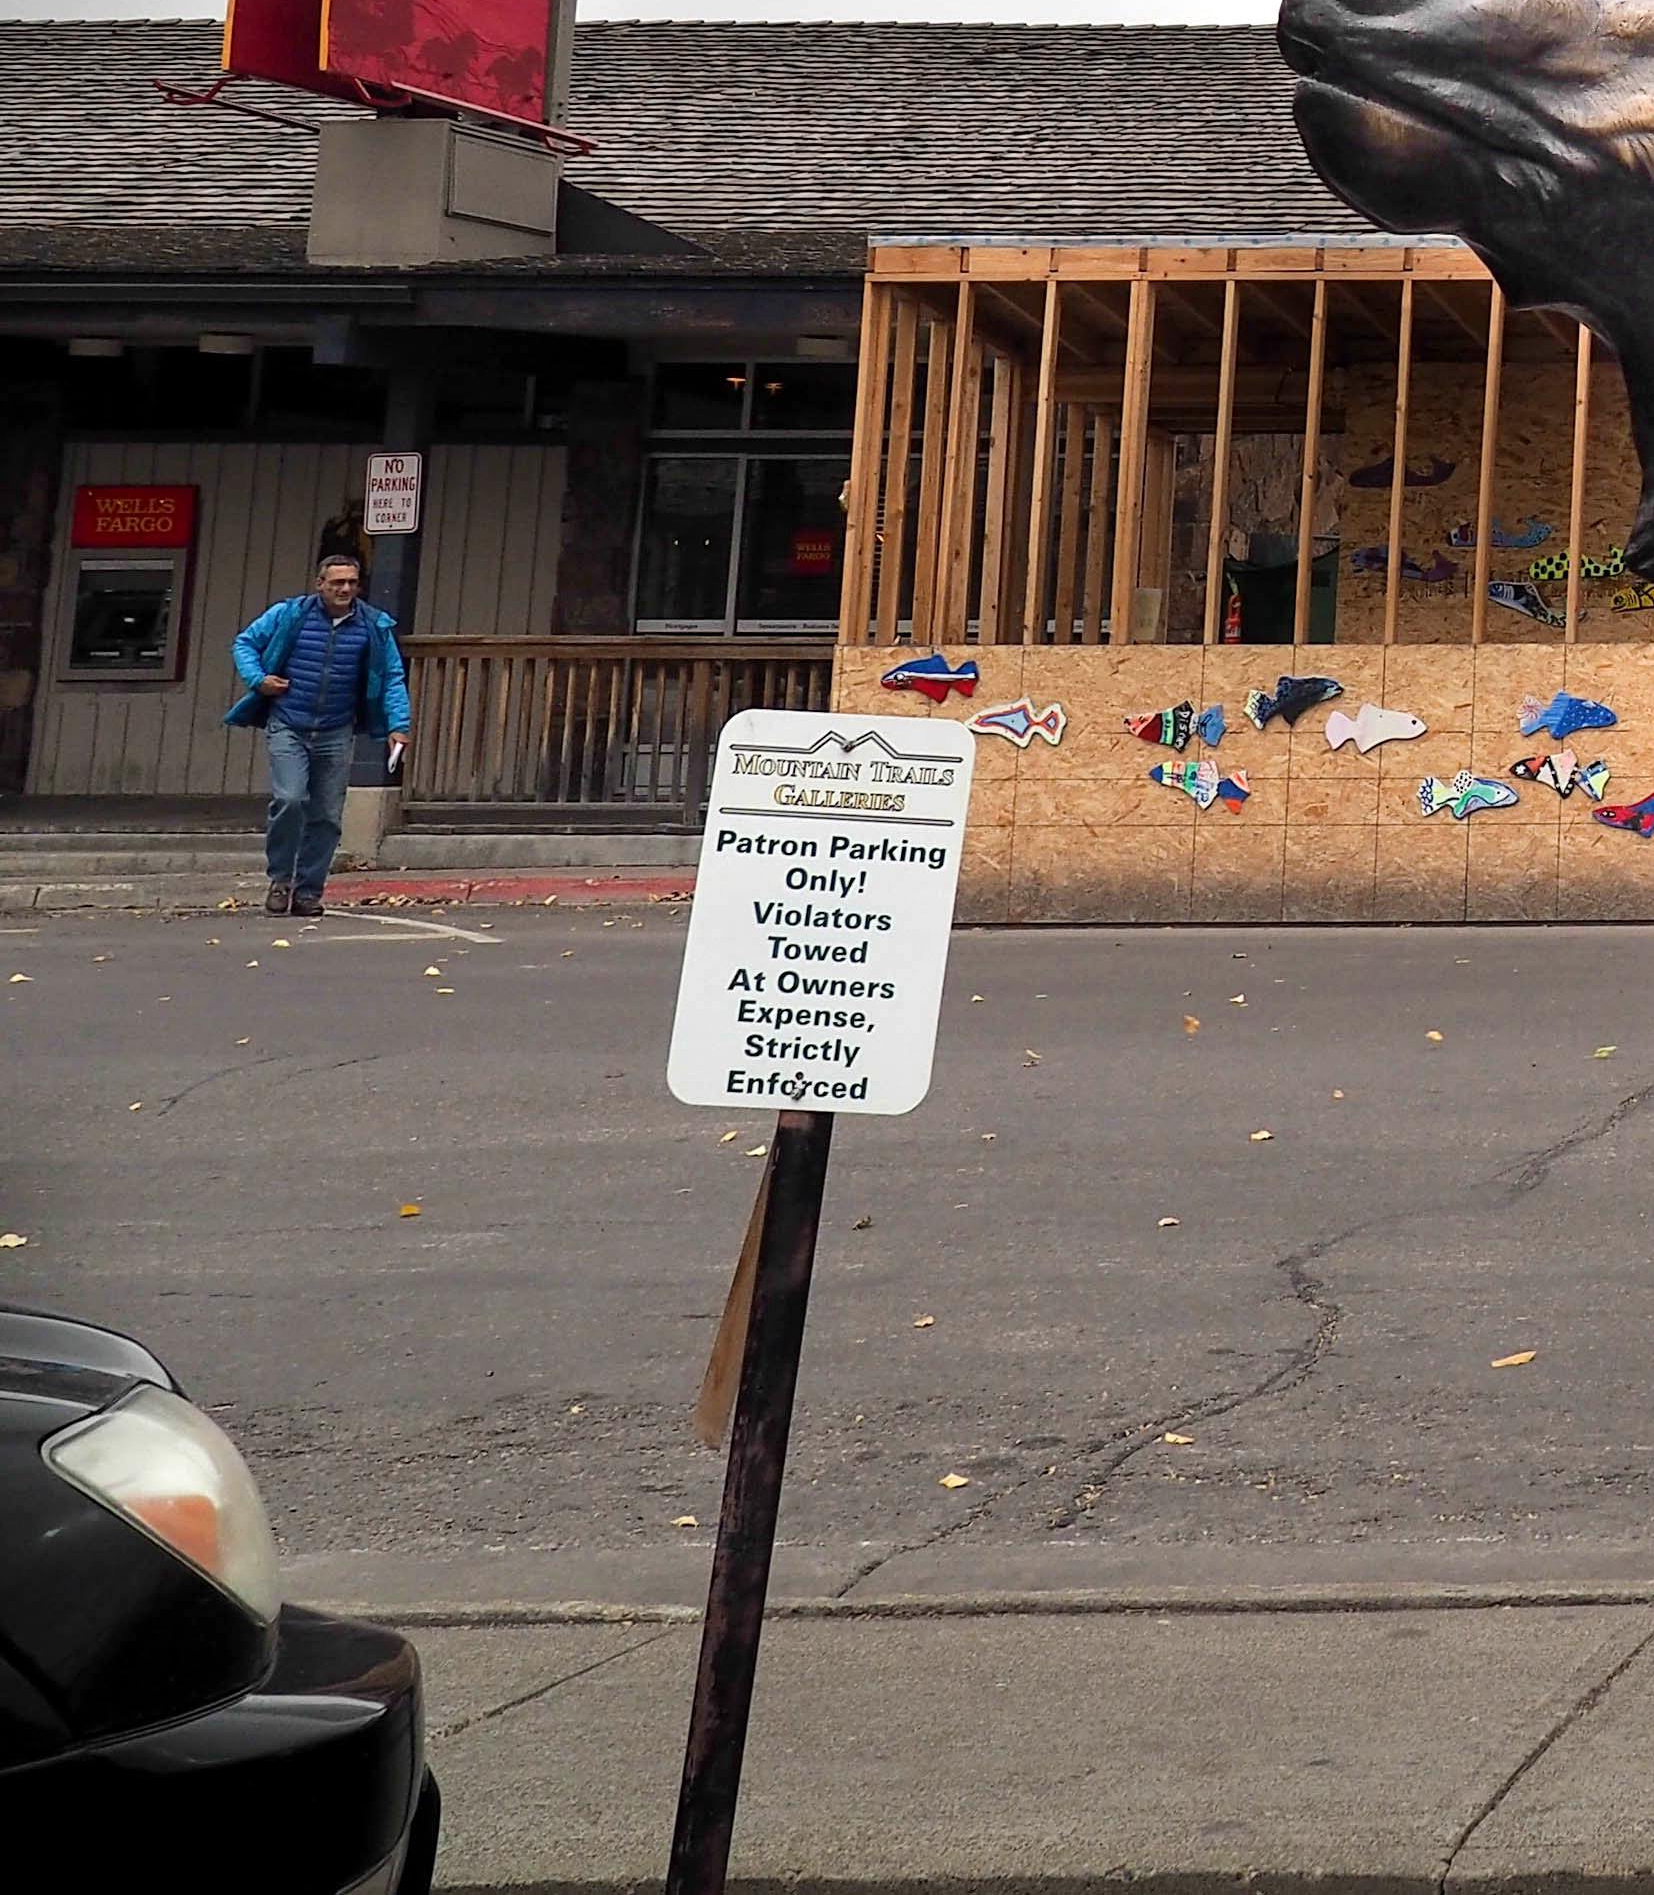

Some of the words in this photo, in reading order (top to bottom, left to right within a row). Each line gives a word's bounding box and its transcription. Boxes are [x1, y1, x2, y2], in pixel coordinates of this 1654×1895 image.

[385, 459, 404, 473] NO
[371, 477, 415, 492] PARKING
[96, 498, 175, 513] WELLS
[401, 498, 411, 508] TO
[96, 517, 173, 532] FARGO
[376, 513, 407, 523] CORNER
[716, 831, 817, 857] Patron
[830, 837, 947, 869] Parking
[786, 868, 866, 898] Only!
[753, 902, 892, 931] Violators
[768, 936, 868, 964] Towed
[728, 969, 765, 992] At
[778, 971, 894, 999] Owners
[738, 1000, 875, 1031] Expense,
[744, 1035, 860, 1068] Strictly
[727, 1071, 868, 1100] Enforced
